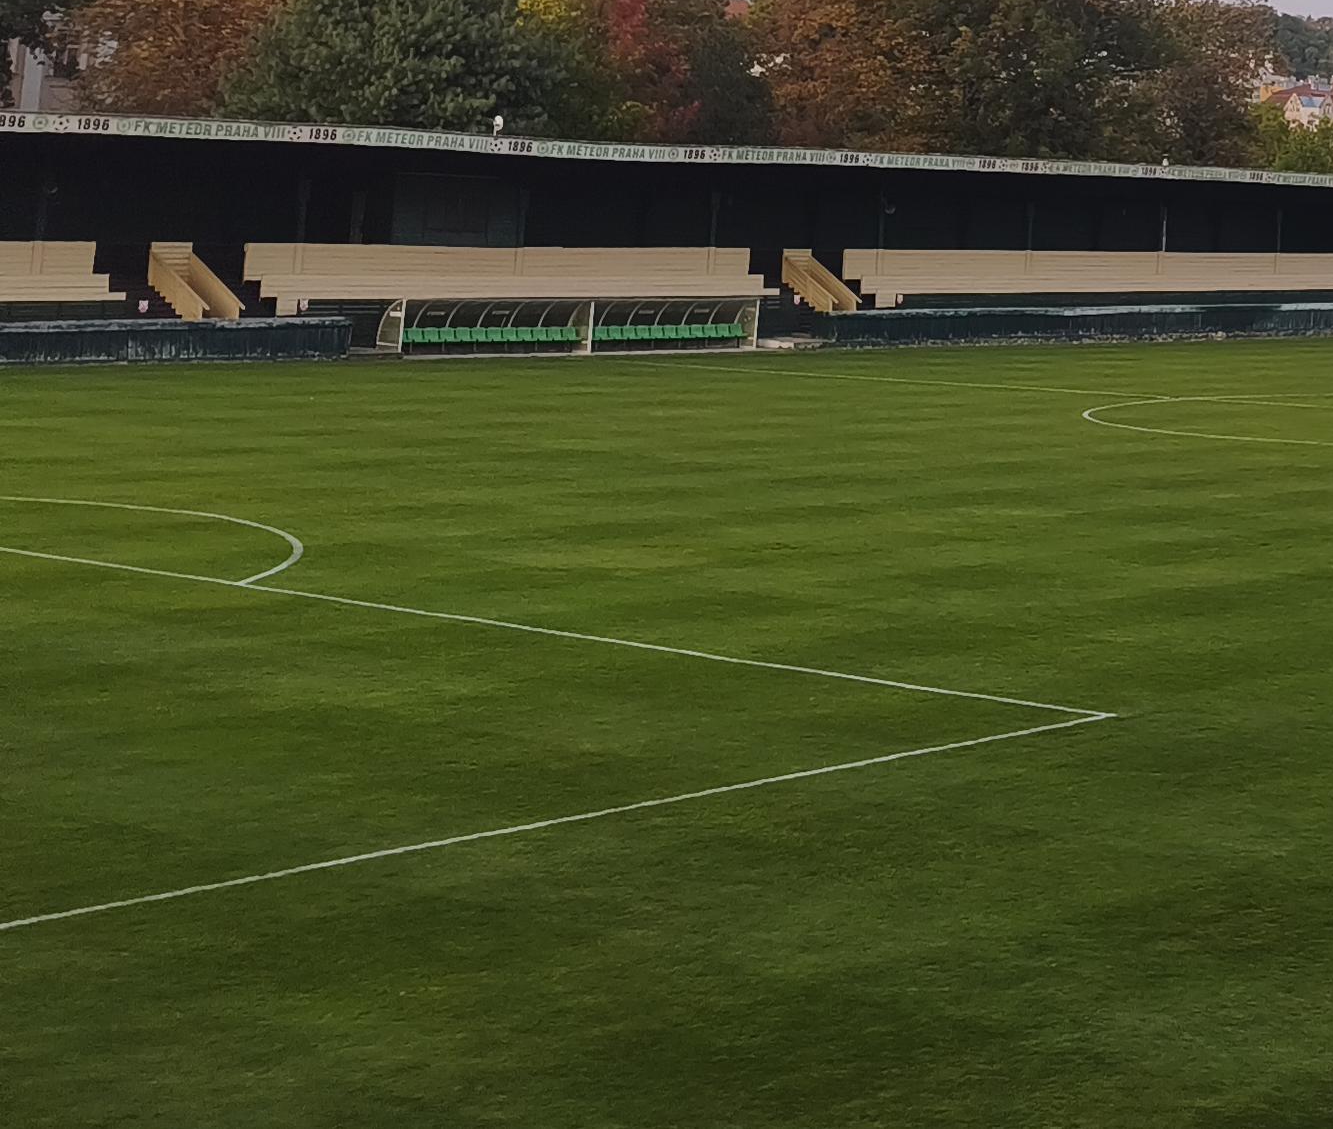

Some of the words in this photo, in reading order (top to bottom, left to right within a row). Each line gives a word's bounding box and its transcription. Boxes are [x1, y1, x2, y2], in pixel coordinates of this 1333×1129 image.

[0, 115, 26, 128] 896
[77, 118, 110, 131] 1896
[134, 120, 151, 133] FK
[155, 121, 212, 136] METEOR
[215, 123, 259, 138] PRAHA
[264, 125, 286, 139] VIII
[309, 128, 338, 141] 1896
[356, 132, 373, 143] FK
[376, 132, 424, 146] METEOR
[427, 135, 465, 149] PRAHA
[469, 138, 488, 151] VIII
[508, 141, 533, 153] 1896
[551, 145, 564, 156] FK
[567, 146, 608, 158] METEOR
[611, 147, 645, 159] PRAHA
[649, 147, 666, 160] VIII
[684, 149, 706, 160] 1896
[721, 149, 733, 160] FK
[736, 150, 774, 161] METEOR
[776, 150, 807, 162] PRAHA
[808, 151, 825, 163] VIII
[887, 156, 920, 167] METEOR
[923, 158, 950, 168] PRAHA
[978, 159, 996, 169] 1896
